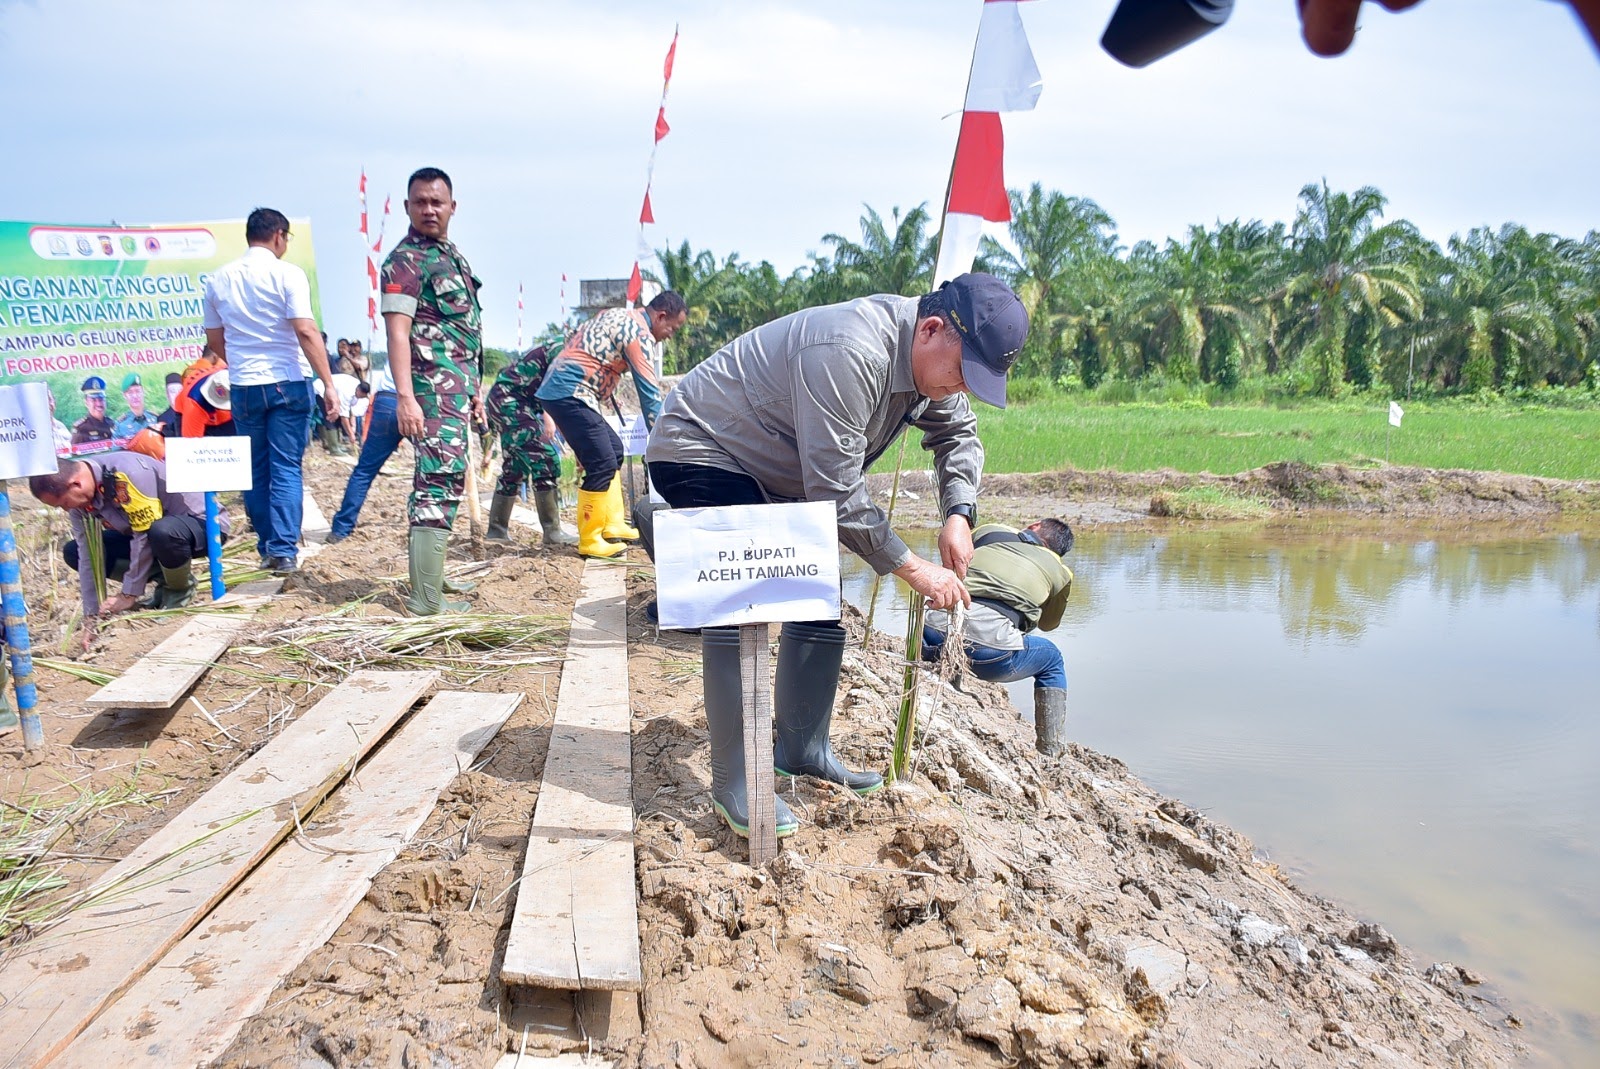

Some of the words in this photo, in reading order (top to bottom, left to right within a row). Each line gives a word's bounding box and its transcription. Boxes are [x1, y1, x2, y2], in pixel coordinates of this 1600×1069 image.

[103, 276, 196, 297] TANGGUL
[11, 302, 154, 325] PENANAMAN
[80, 329, 137, 347] GELUNG
[6, 353, 122, 374] FORKOPIMDA
[718, 550, 739, 562] PJ.
[743, 546, 796, 561] BUPATI
[697, 568, 741, 582] ACEH
[745, 564, 819, 580] TAMIANG
